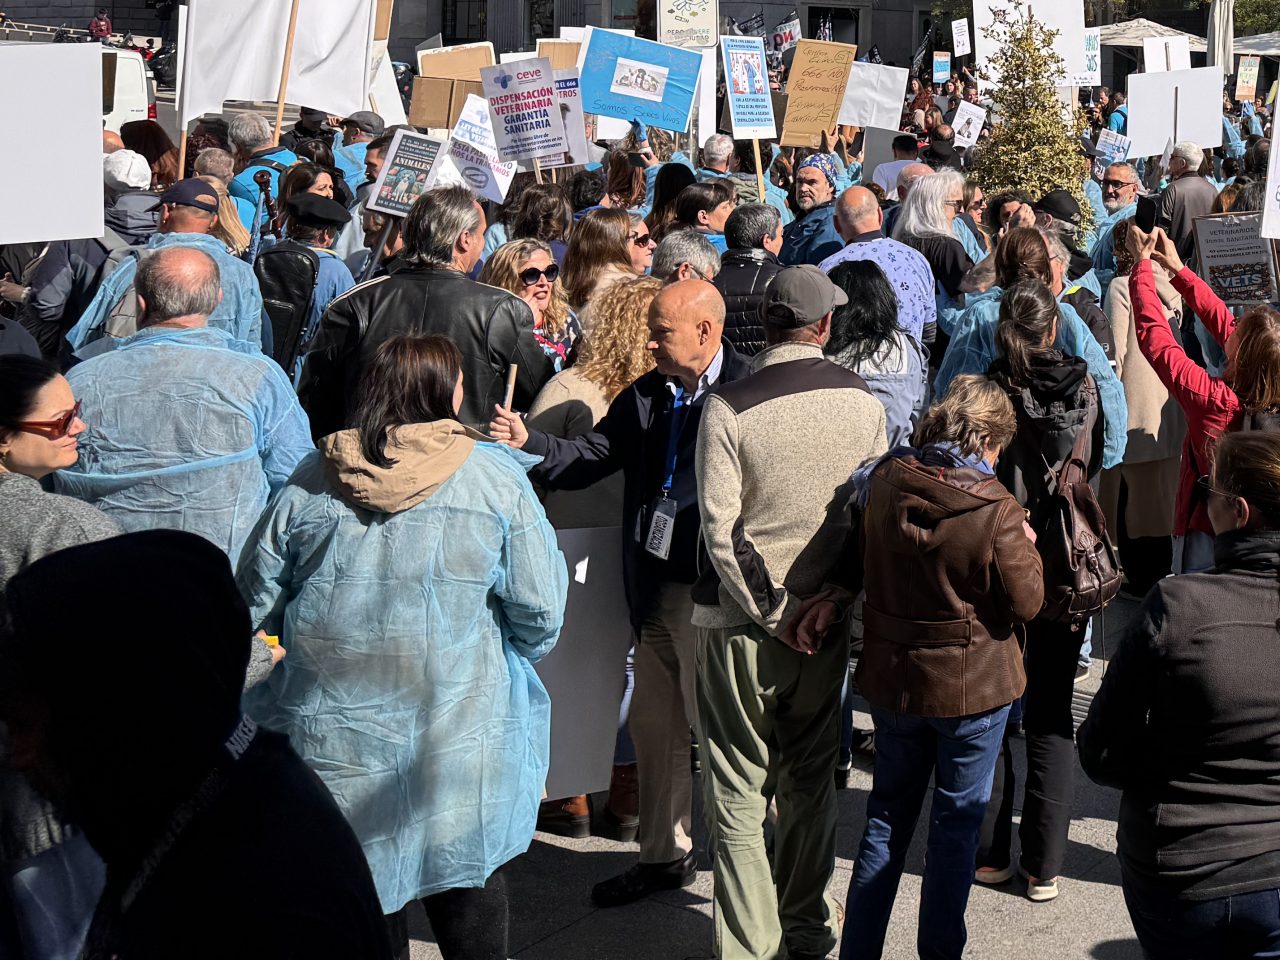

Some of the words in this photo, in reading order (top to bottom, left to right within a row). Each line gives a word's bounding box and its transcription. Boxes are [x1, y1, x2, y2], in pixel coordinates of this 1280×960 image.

[516, 69, 542, 80] ceve
[801, 66, 827, 78] 666
[490, 86, 553, 106] DISPENSACIÓN
[494, 98, 553, 115] VETERINARIA
[504, 108, 549, 124] GARANTÍA
[504, 119, 551, 135] SANITARIA
[453, 142, 469, 152] ESTA
[394, 157, 432, 171] ANIMALES
[450, 148, 465, 158] NOS
[475, 157, 510, 177] TRAGAMOS
[1217, 273, 1262, 288] VETS
